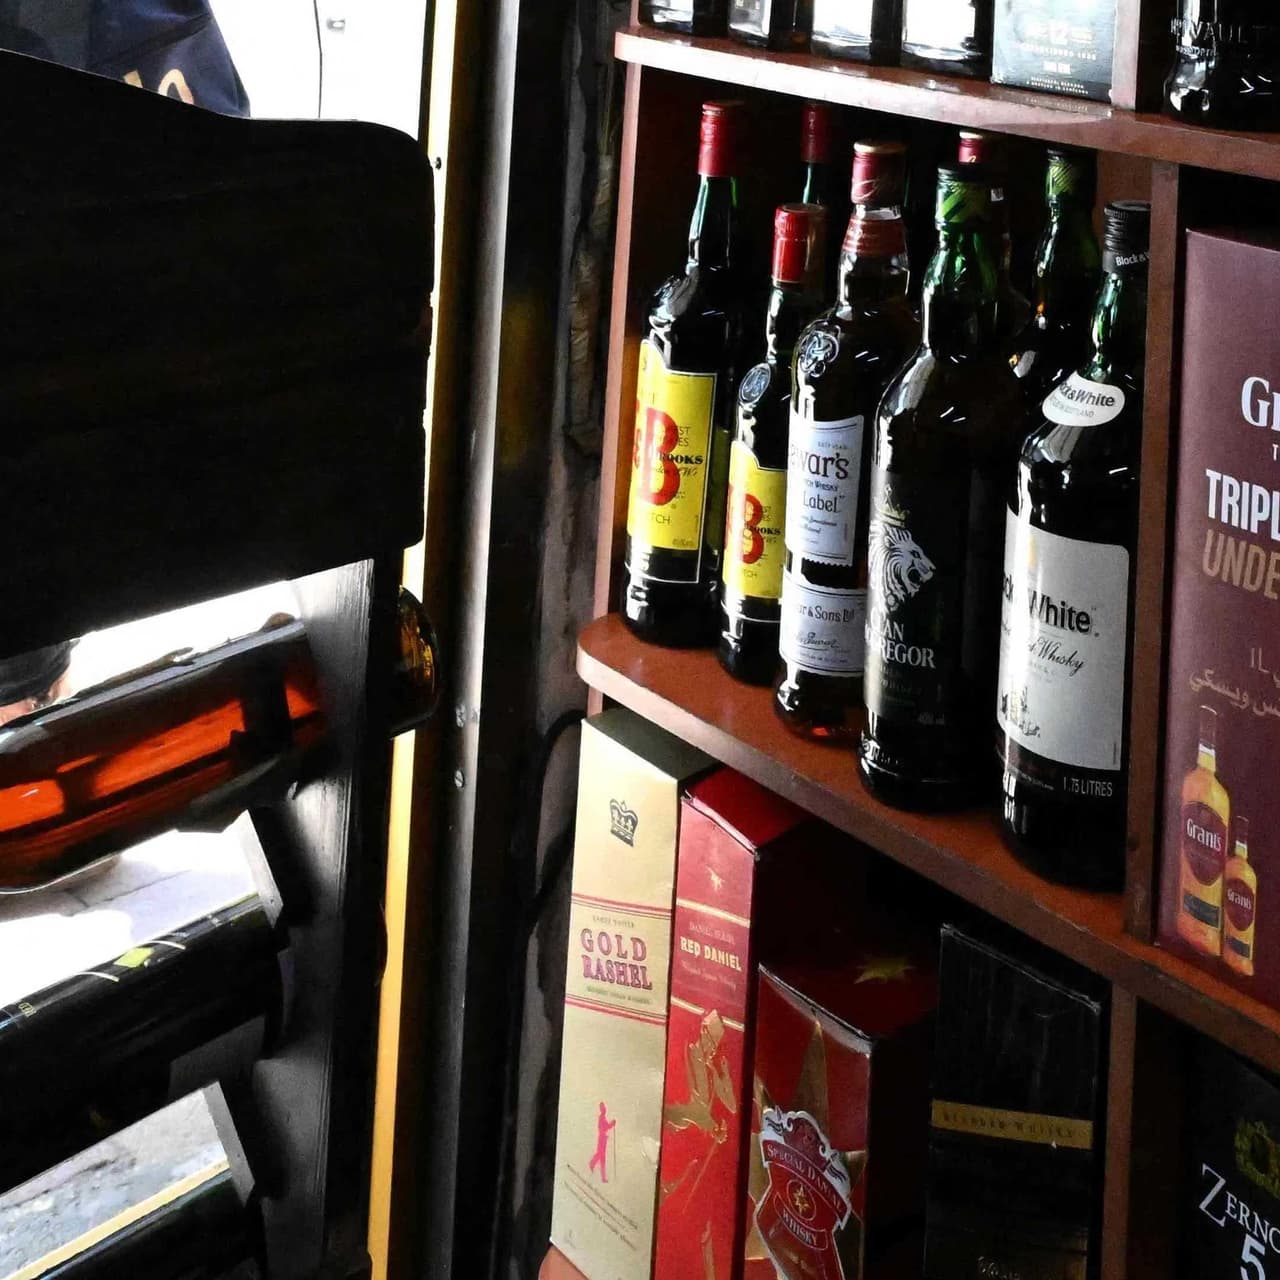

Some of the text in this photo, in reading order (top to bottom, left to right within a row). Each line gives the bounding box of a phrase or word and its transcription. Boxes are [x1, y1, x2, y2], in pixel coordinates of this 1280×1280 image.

[1036, 638, 1085, 677] Whisky
[1081, 778, 1113, 797] LITRES
[581, 928, 647, 962] GOLD
[680, 936, 742, 971] RED DANIEL
[582, 954, 653, 990] RASHEL
[782, 1210, 818, 1246] WHISKY
